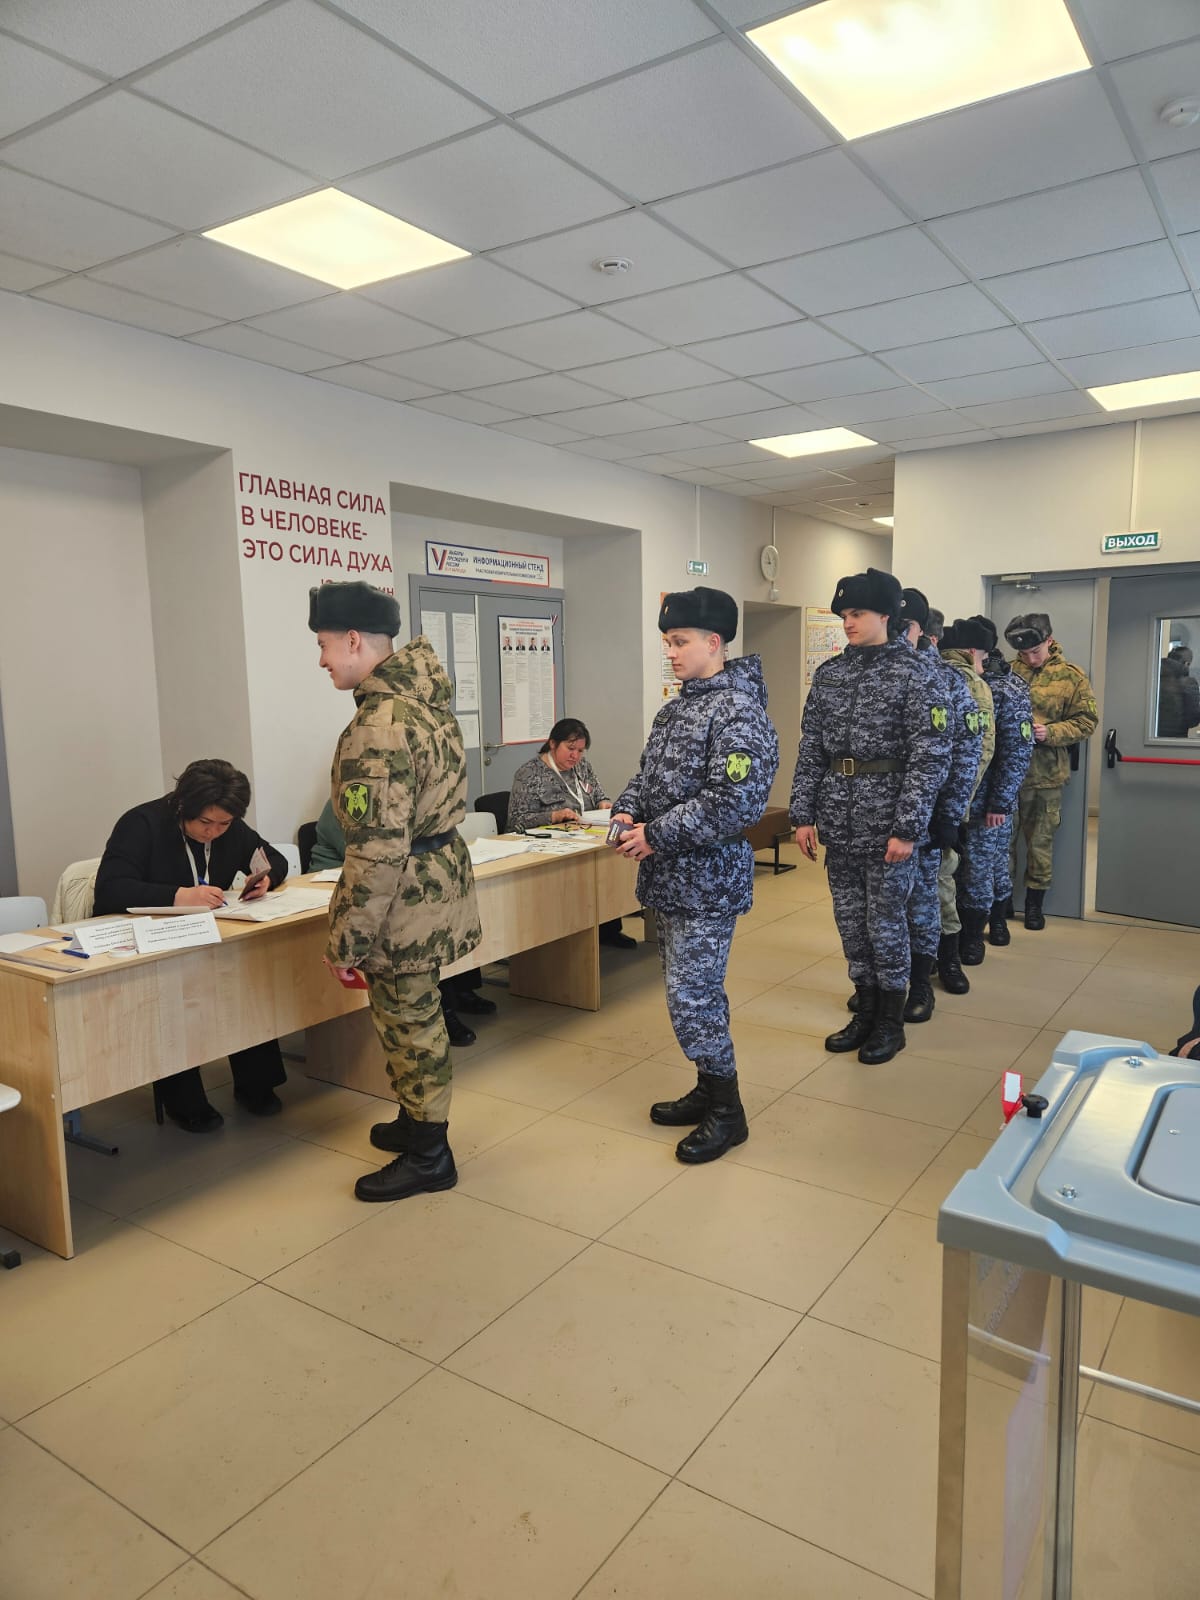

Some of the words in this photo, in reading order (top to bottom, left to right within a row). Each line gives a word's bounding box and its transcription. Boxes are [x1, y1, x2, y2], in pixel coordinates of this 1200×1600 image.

[239, 472, 331, 506] ГЛАВНАЯ
[337, 490, 386, 515] СИЛА
[241, 505, 255, 526] В
[261, 508, 368, 541] ЧЕЛОВЕКЕ-
[243, 538, 284, 561] ЭТО
[289, 544, 343, 567] СИЛА
[347, 550, 393, 573] ДУХА
[1108, 534, 1156, 548] ВЫХОД
[473, 556, 526, 569] ИНФОРМАЦИОННЫЙ
[527, 562, 544, 572] СТЕНД
